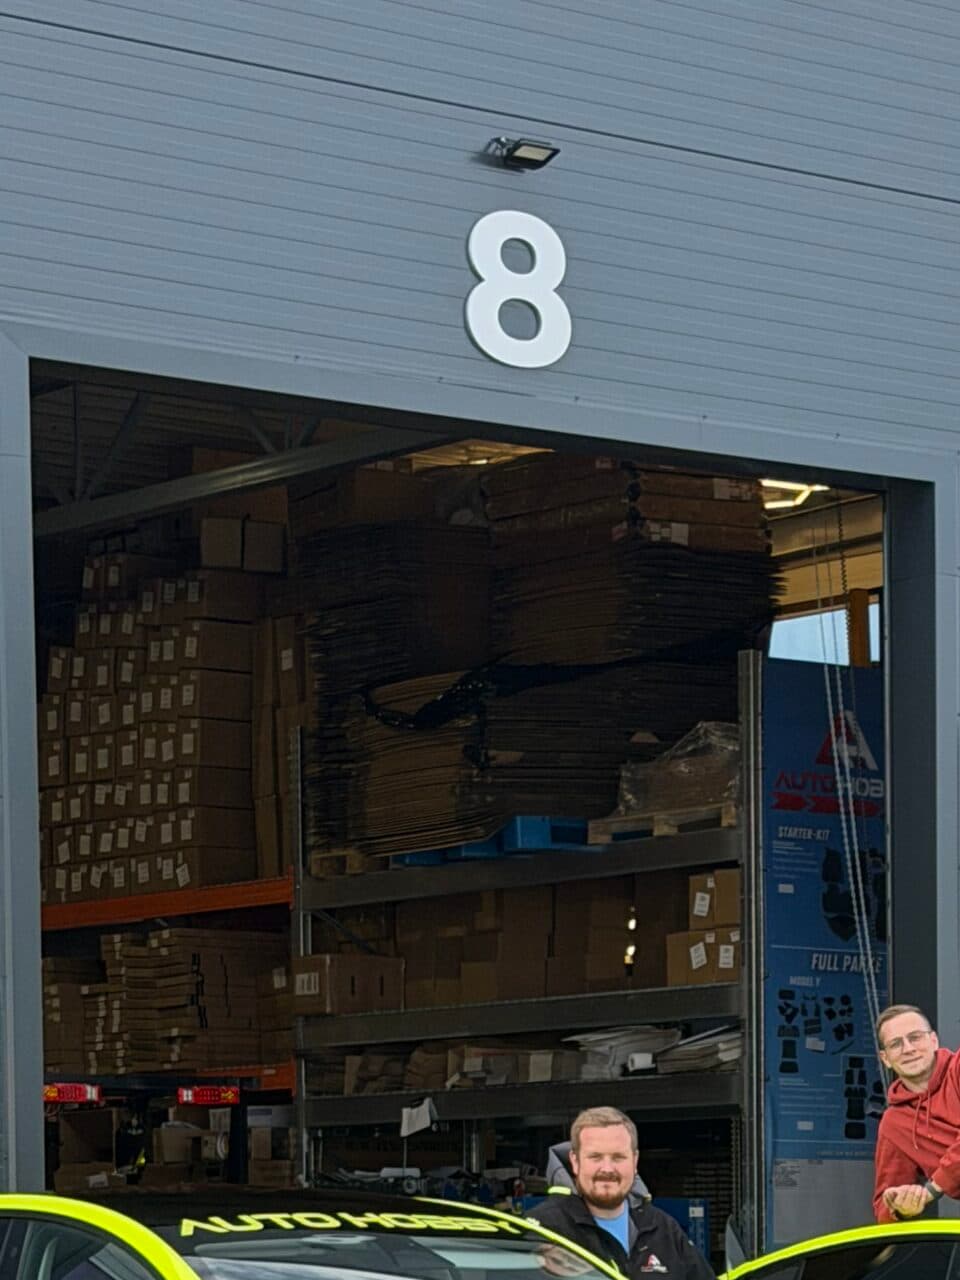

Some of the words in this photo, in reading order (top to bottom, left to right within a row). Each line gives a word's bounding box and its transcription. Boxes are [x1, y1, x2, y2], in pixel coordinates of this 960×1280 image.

[467, 209, 571, 368] 8
[778, 826, 832, 840] STARTER-KIT
[811, 953, 839, 971] FULL
[180, 1213, 341, 1237] AUTO
[336, 1213, 522, 1235] HOBBY
